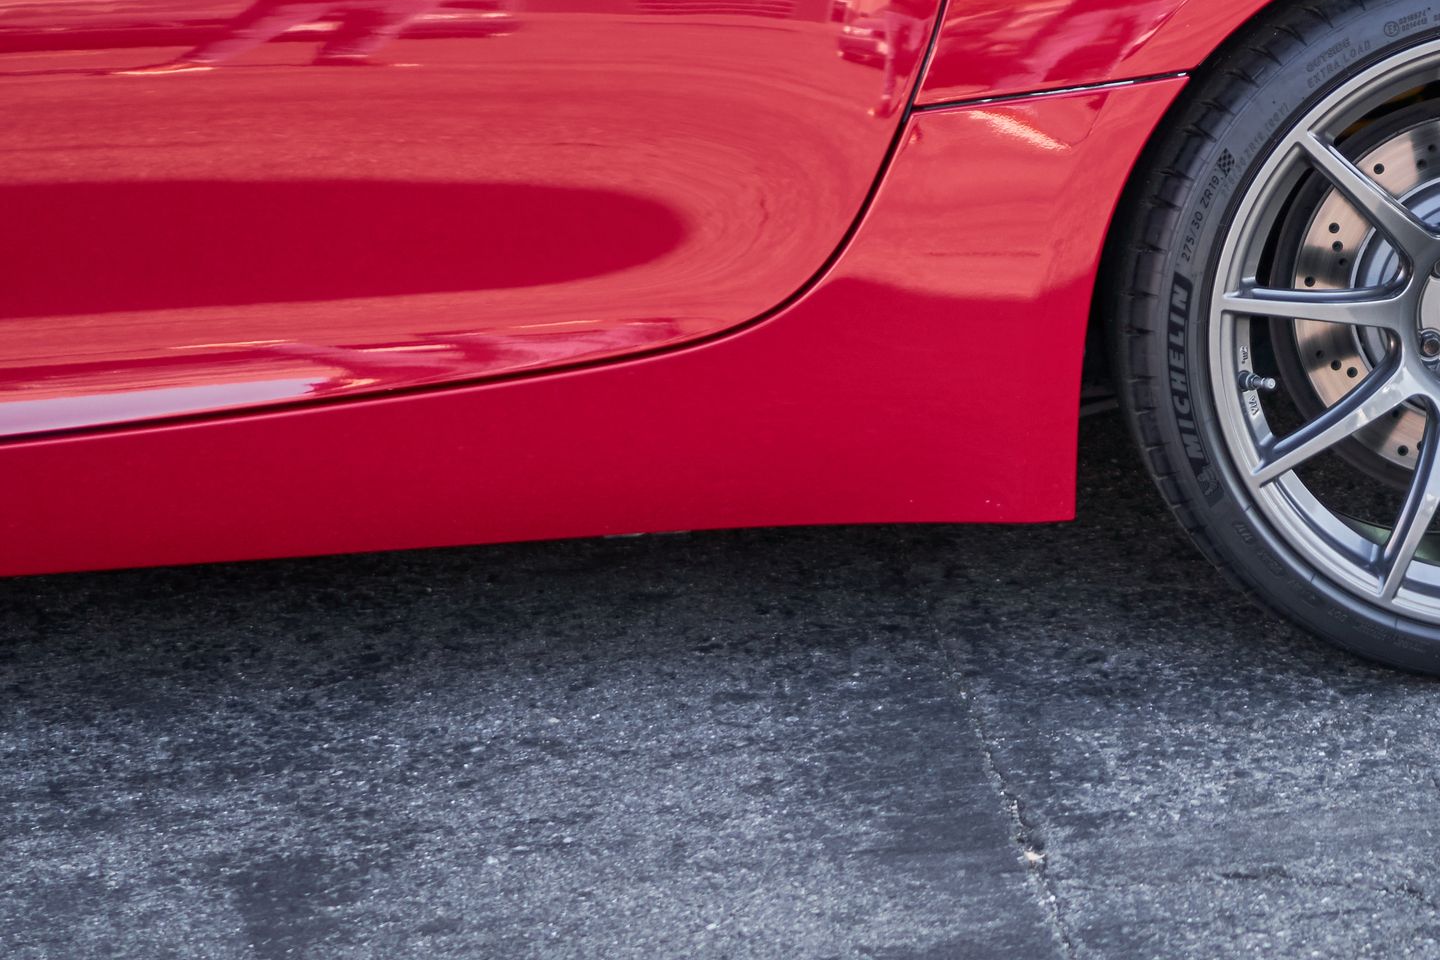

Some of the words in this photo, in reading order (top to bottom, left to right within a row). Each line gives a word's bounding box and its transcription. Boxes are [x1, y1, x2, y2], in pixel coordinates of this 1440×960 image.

[1306, 39, 1350, 73] OUTSIDE
[1307, 59, 1344, 88] EXTRA
[1344, 40, 1371, 62] LOAD
[1181, 211, 1203, 263] 275/30
[1200, 175, 1220, 209] ZR19
[1168, 284, 1204, 459] MICHELIN
